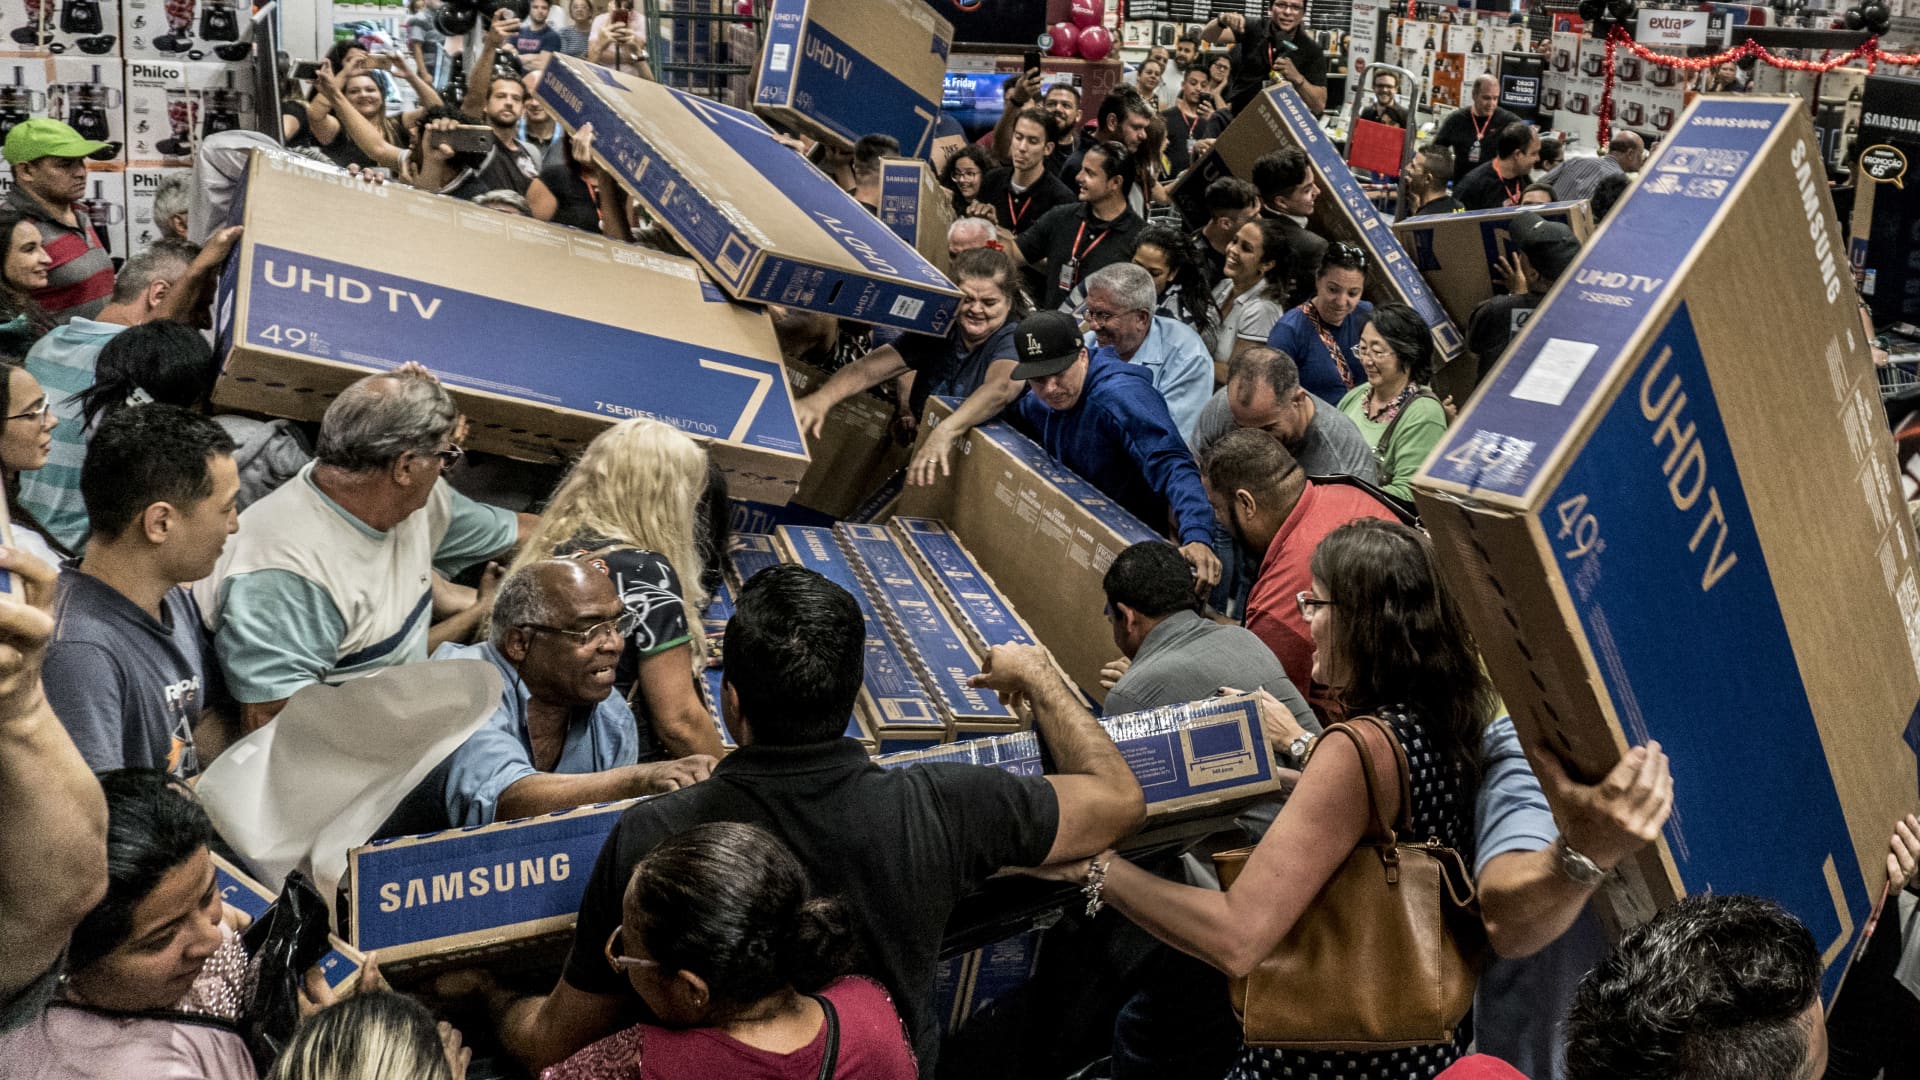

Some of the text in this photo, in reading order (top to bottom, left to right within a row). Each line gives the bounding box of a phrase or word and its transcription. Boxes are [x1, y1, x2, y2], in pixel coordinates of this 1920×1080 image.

[1649, 16, 1681, 30] extra
[132, 64, 180, 79] Philco
[805, 33, 854, 80] UHD TV
[545, 72, 583, 112] SAMSUNG
[952, 78, 977, 89] Friday
[1279, 92, 1318, 143] SAMSUNG
[1691, 116, 1773, 130] SAMSUNG
[270, 156, 389, 198] SAMSUNG
[1790, 138, 1841, 304] SAMSUNG
[814, 210, 899, 275] UHD TV
[264, 260, 442, 320] UHD TV
[760, 261, 783, 297] SAMSUNG
[1575, 268, 1664, 293] UHD TV
[594, 401, 603, 410] 7
[699, 358, 774, 443] 7
[1639, 344, 1739, 592] UHD TV
[750, 510, 776, 535] TV
[801, 529, 830, 561] SAMSUNG
[946, 667, 990, 711] SAMSUNG
[379, 852, 570, 913] SAMSUNG
